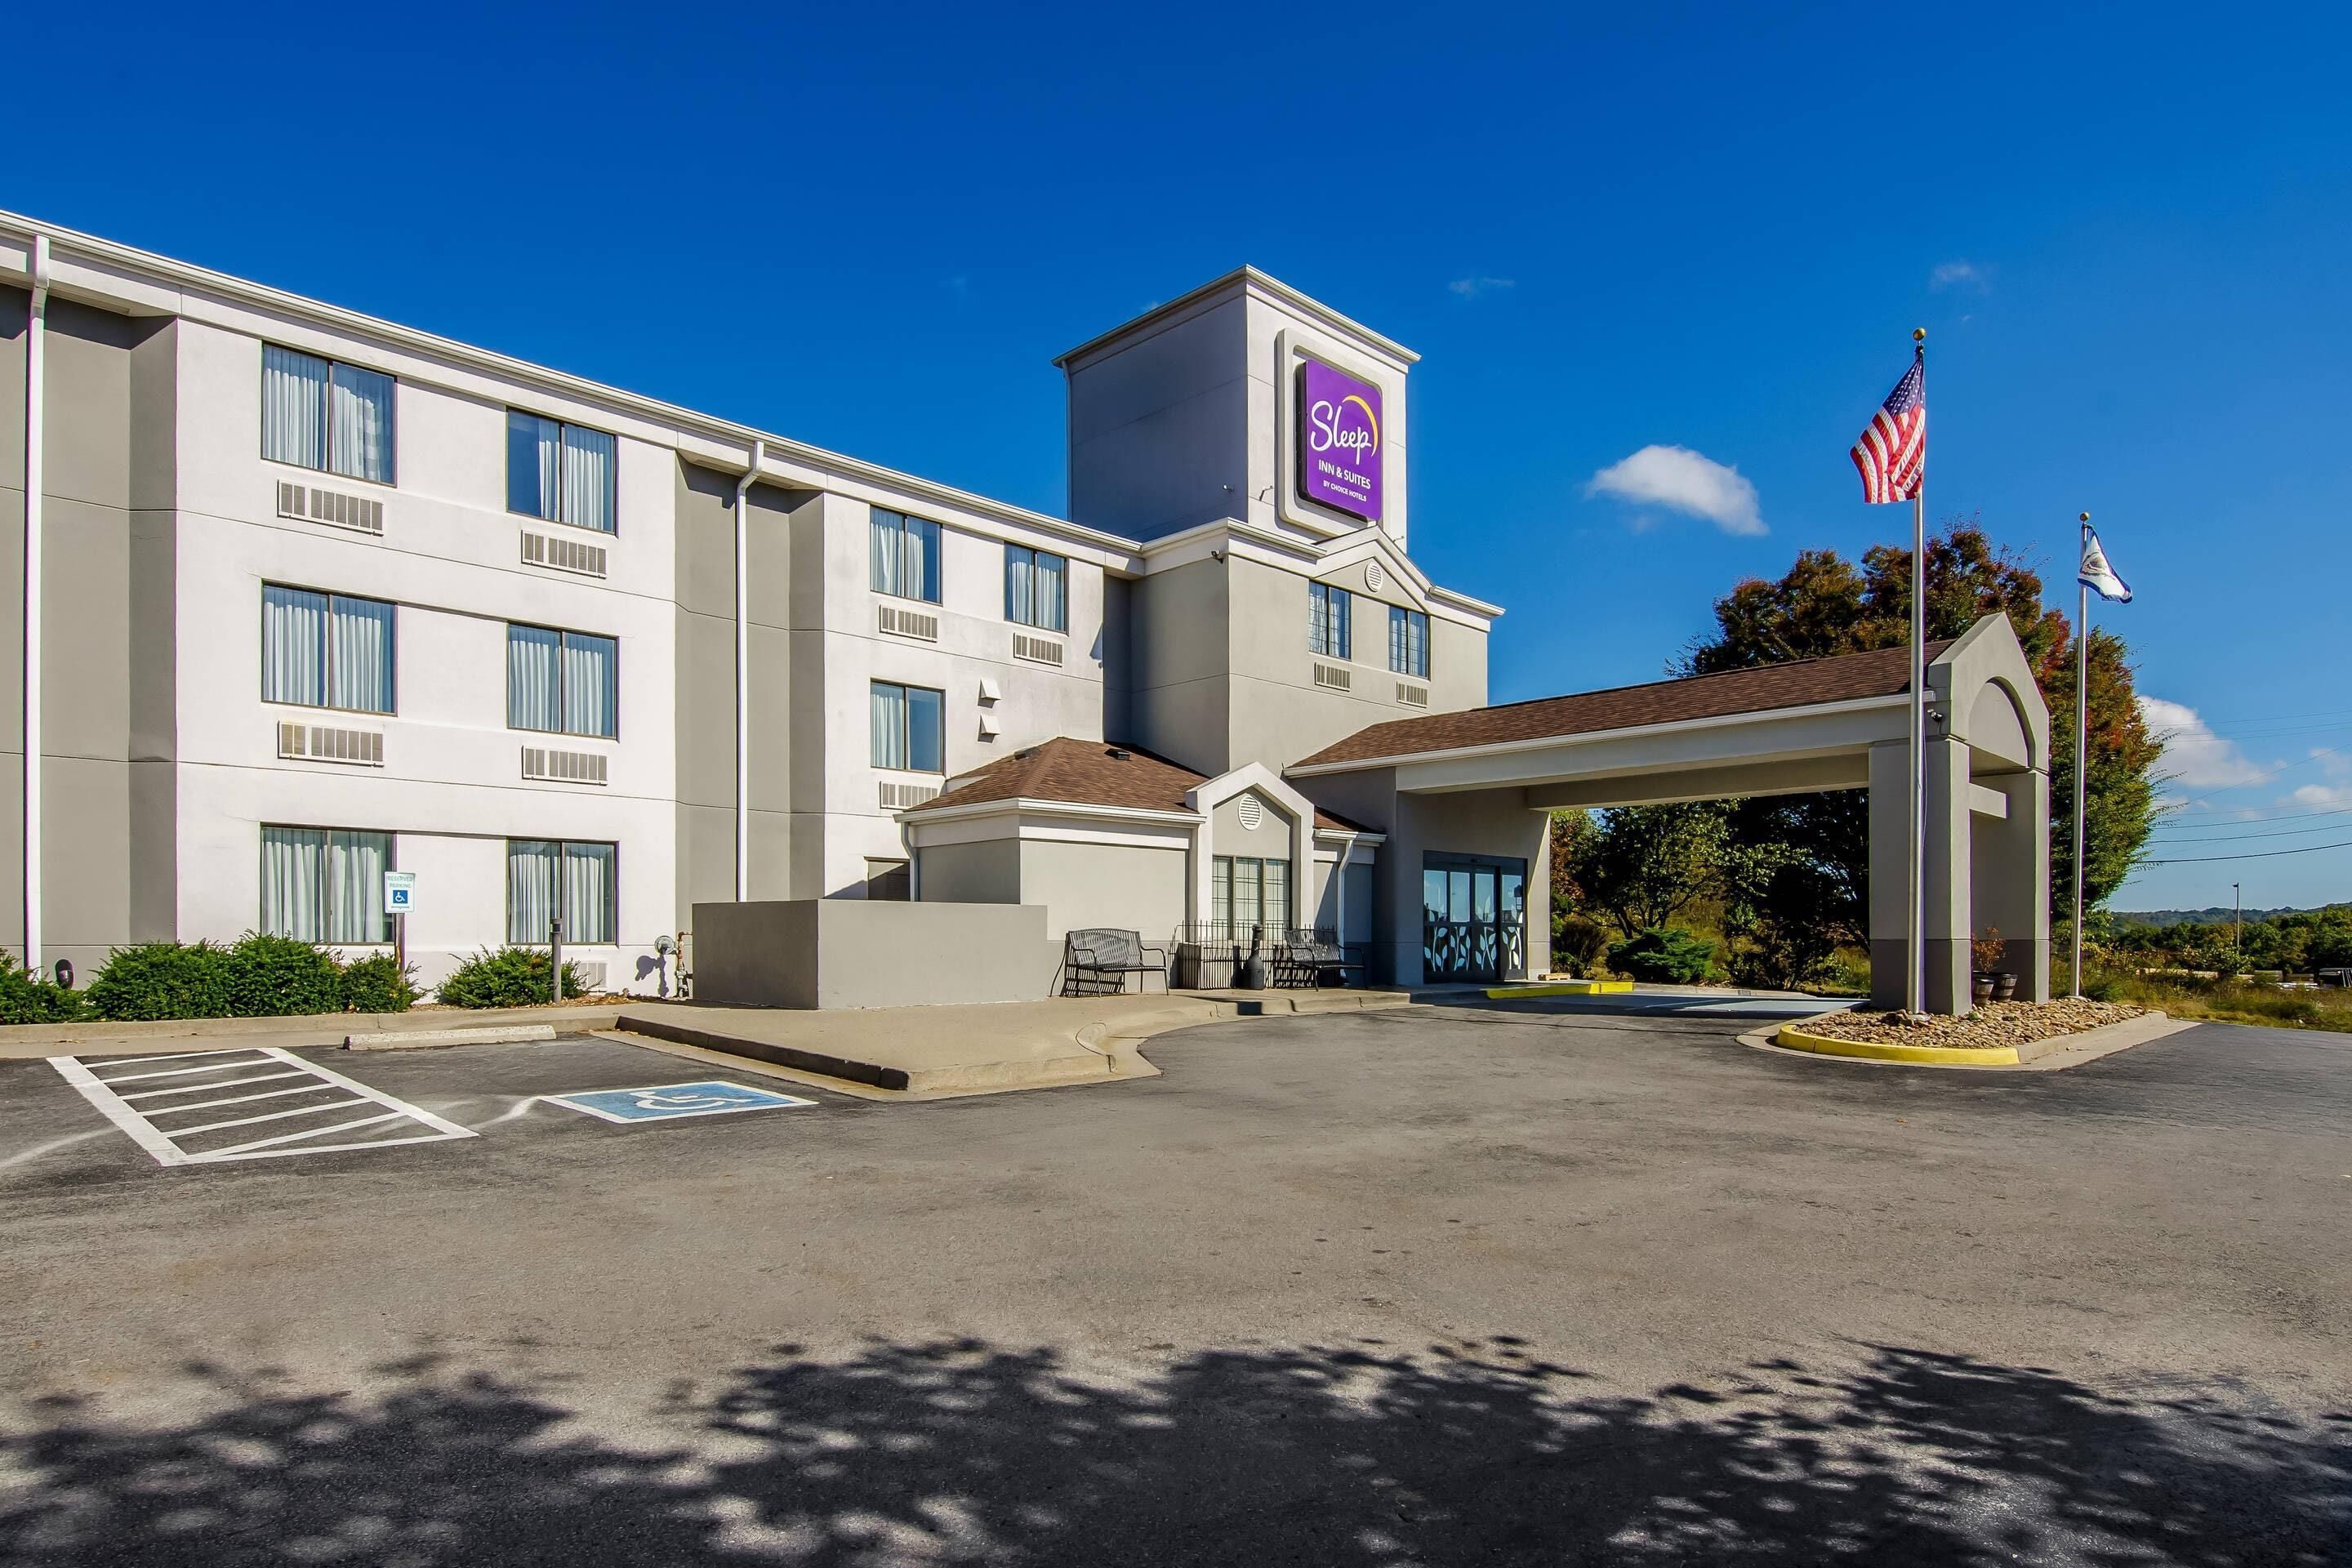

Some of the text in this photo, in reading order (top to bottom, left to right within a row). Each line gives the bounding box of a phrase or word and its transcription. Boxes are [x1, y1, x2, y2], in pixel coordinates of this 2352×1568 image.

[1310, 400, 1372, 466] Sleep
[1318, 459, 1371, 490] INN & SUITES
[1323, 480, 1367, 502] BY CHOICE HOTELS
